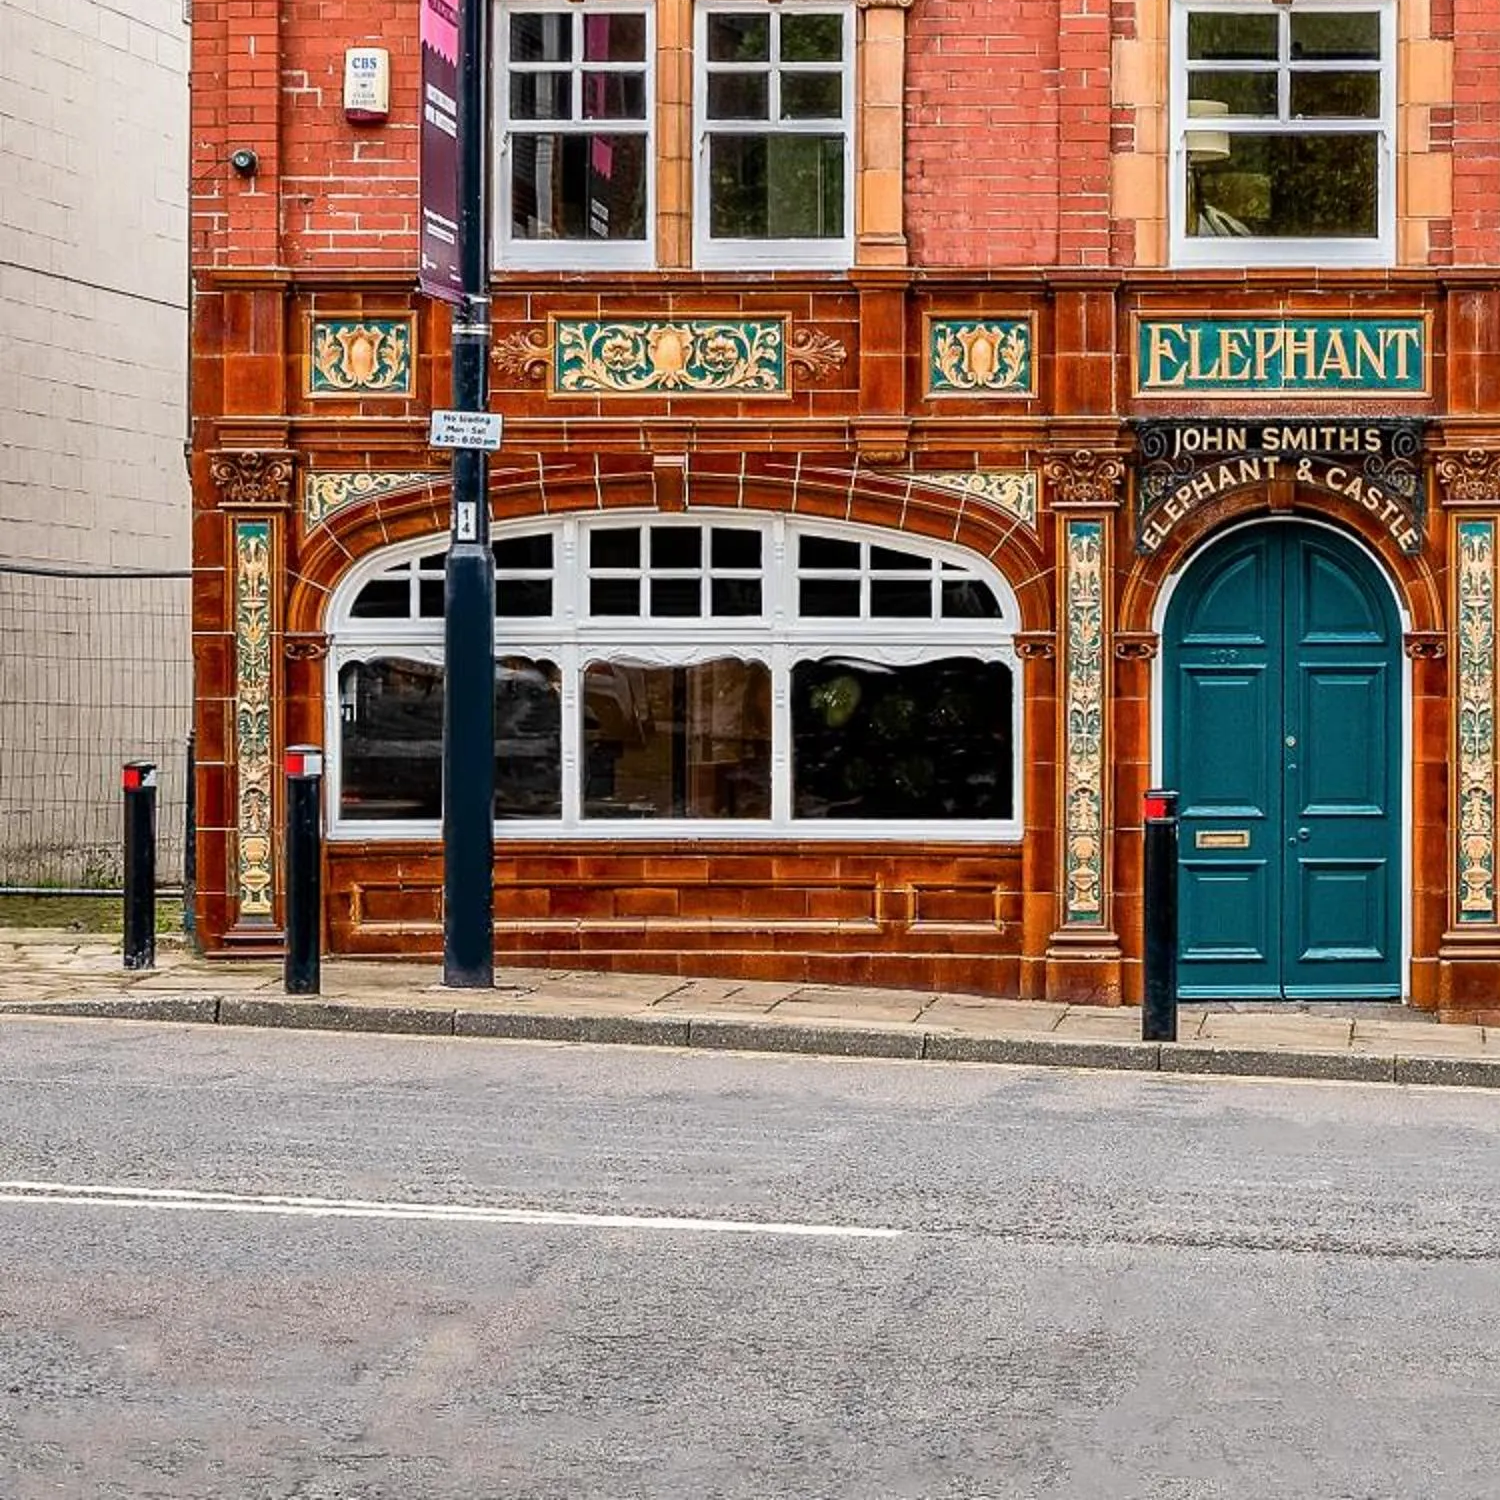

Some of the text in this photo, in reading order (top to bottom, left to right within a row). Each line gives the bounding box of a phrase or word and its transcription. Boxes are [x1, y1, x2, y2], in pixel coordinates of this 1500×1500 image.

[351, 57, 378, 70] CBS
[1144, 322, 1420, 388] ELEPHANT
[1173, 427, 1382, 458] JOHN SMITHS
[1142, 456, 1419, 550] ELEPHANT & CASTLE
